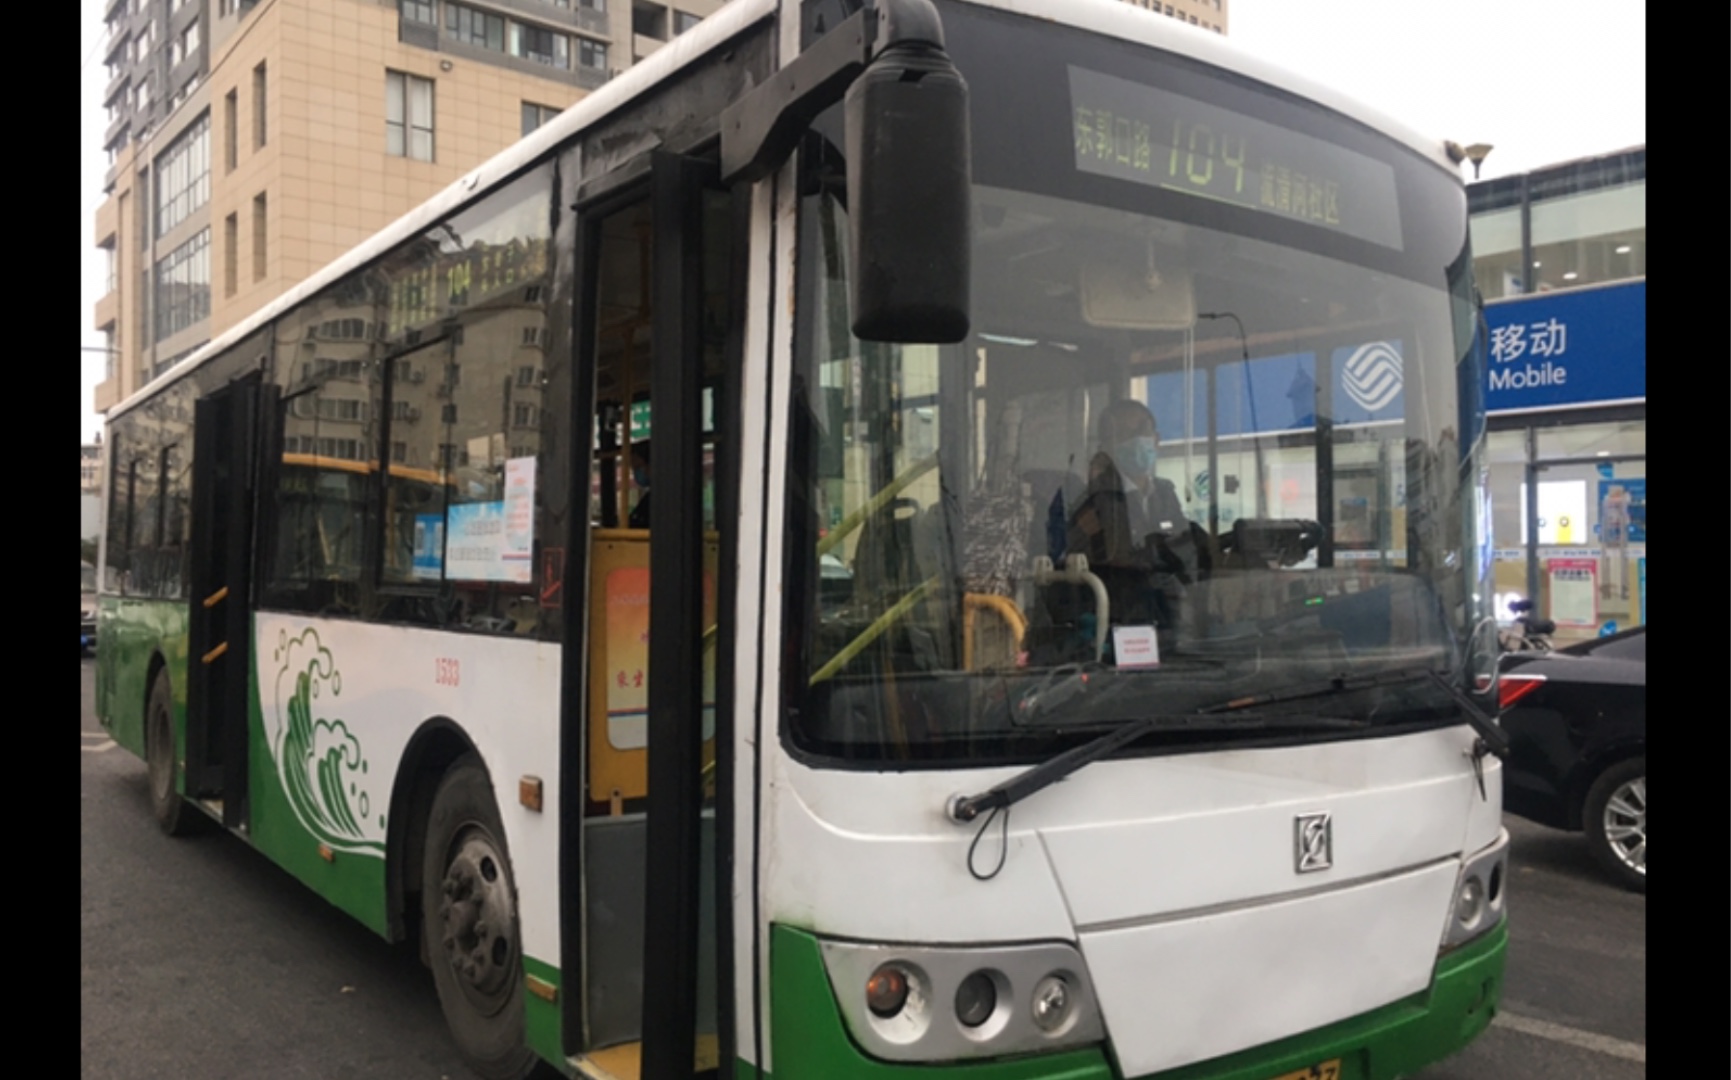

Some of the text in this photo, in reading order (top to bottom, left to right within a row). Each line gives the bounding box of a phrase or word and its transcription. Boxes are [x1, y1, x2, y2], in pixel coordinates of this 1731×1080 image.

[1166, 119, 1246, 193] 104
[1490, 317, 1567, 363] 移动
[1489, 362, 1567, 391] Mobile
[435, 657, 460, 687] 1533
